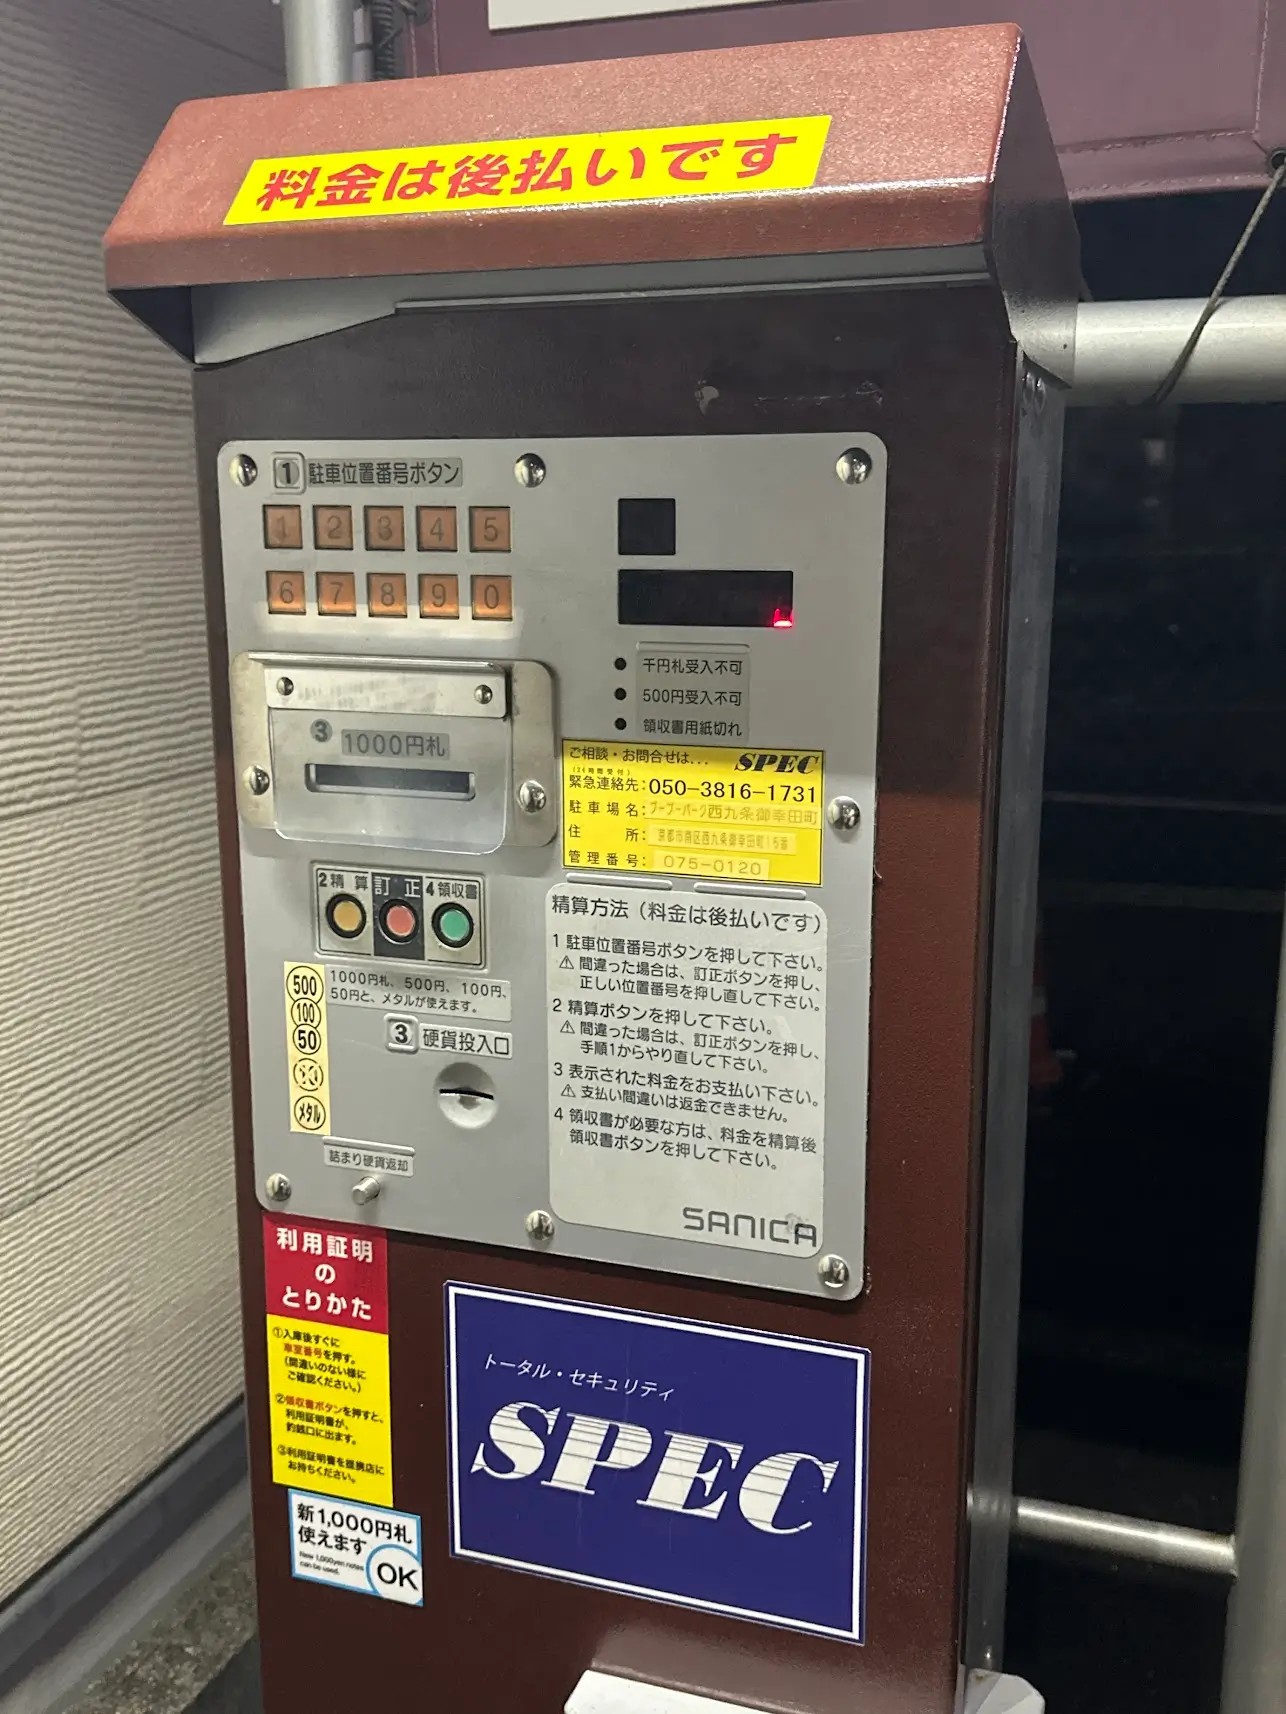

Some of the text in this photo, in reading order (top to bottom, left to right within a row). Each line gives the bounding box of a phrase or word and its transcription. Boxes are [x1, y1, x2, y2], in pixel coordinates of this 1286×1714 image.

[256, 133, 798, 211] 料金は後払いです
[281, 462, 461, 485] 1 駐車位置番号ボタン
[274, 515, 499, 542] 1 2 3 4 5
[279, 580, 499, 609] 6 7 8 9 0
[642, 657, 743, 675] 千円札受入不可
[642, 688, 742, 706] 500円受入不可
[313, 719, 330, 743] 3
[643, 718, 742, 736] 領収書用紙切れ
[344, 733, 446, 757] 1000円札
[734, 752, 820, 775] SPEC
[649, 778, 816, 803] 050-3816-1731
[664, 855, 762, 875] 075-0120
[318, 872, 369, 891] 2 精算
[374, 876, 421, 898] 訂正
[425, 883, 478, 900] 4 領収書
[551, 894, 821, 934] 精算方法（料金は後払いです）
[553, 934, 823, 972] 1 駐車位置番号ボタンを押して下さい。
[292, 974, 317, 996] 500
[579, 956, 820, 992] 間違った場合は、訂正ボタンを押し、
[331, 988, 477, 1013] 50円と、メタルが使えます。
[580, 975, 820, 1012] 正しい位置番号を押し直して下さい。
[296, 1002, 315, 1024] 100
[553, 998, 773, 1035] 2 精算ボタンを押して下さい。
[297, 1029, 317, 1050] 50
[395, 1024, 509, 1055] 3 硬貨投入口
[580, 1022, 820, 1060] 間違った場合は、訂正ボタンを押し、
[580, 1041, 769, 1074] 手順1からやり直して下さい。
[553, 1063, 819, 1108] 3 表示された料金をお支払い下さい。
[299, 1102, 321, 1124] メタル
[581, 1085, 788, 1123] 支払い間違いは返金できません。
[554, 1107, 817, 1154] 4 領収書が必要な方は、料金を精算後
[329, 1150, 409, 1171] 詰まり硬貨返却
[569, 1129, 777, 1170] 領収書ボタンを押して下さい。
[682, 1206, 817, 1247] SANICA
[276, 1227, 373, 1263] 利用証明
[315, 1263, 336, 1284] の
[282, 1286, 372, 1320] とりかた
[484, 1353, 675, 1402] トータル・セキュリティ
[470, 1401, 840, 1534] SPEC
[297, 1503, 413, 1544] 新1,000円札
[298, 1525, 367, 1555] 使えます
[377, 1562, 419, 1592] OK
